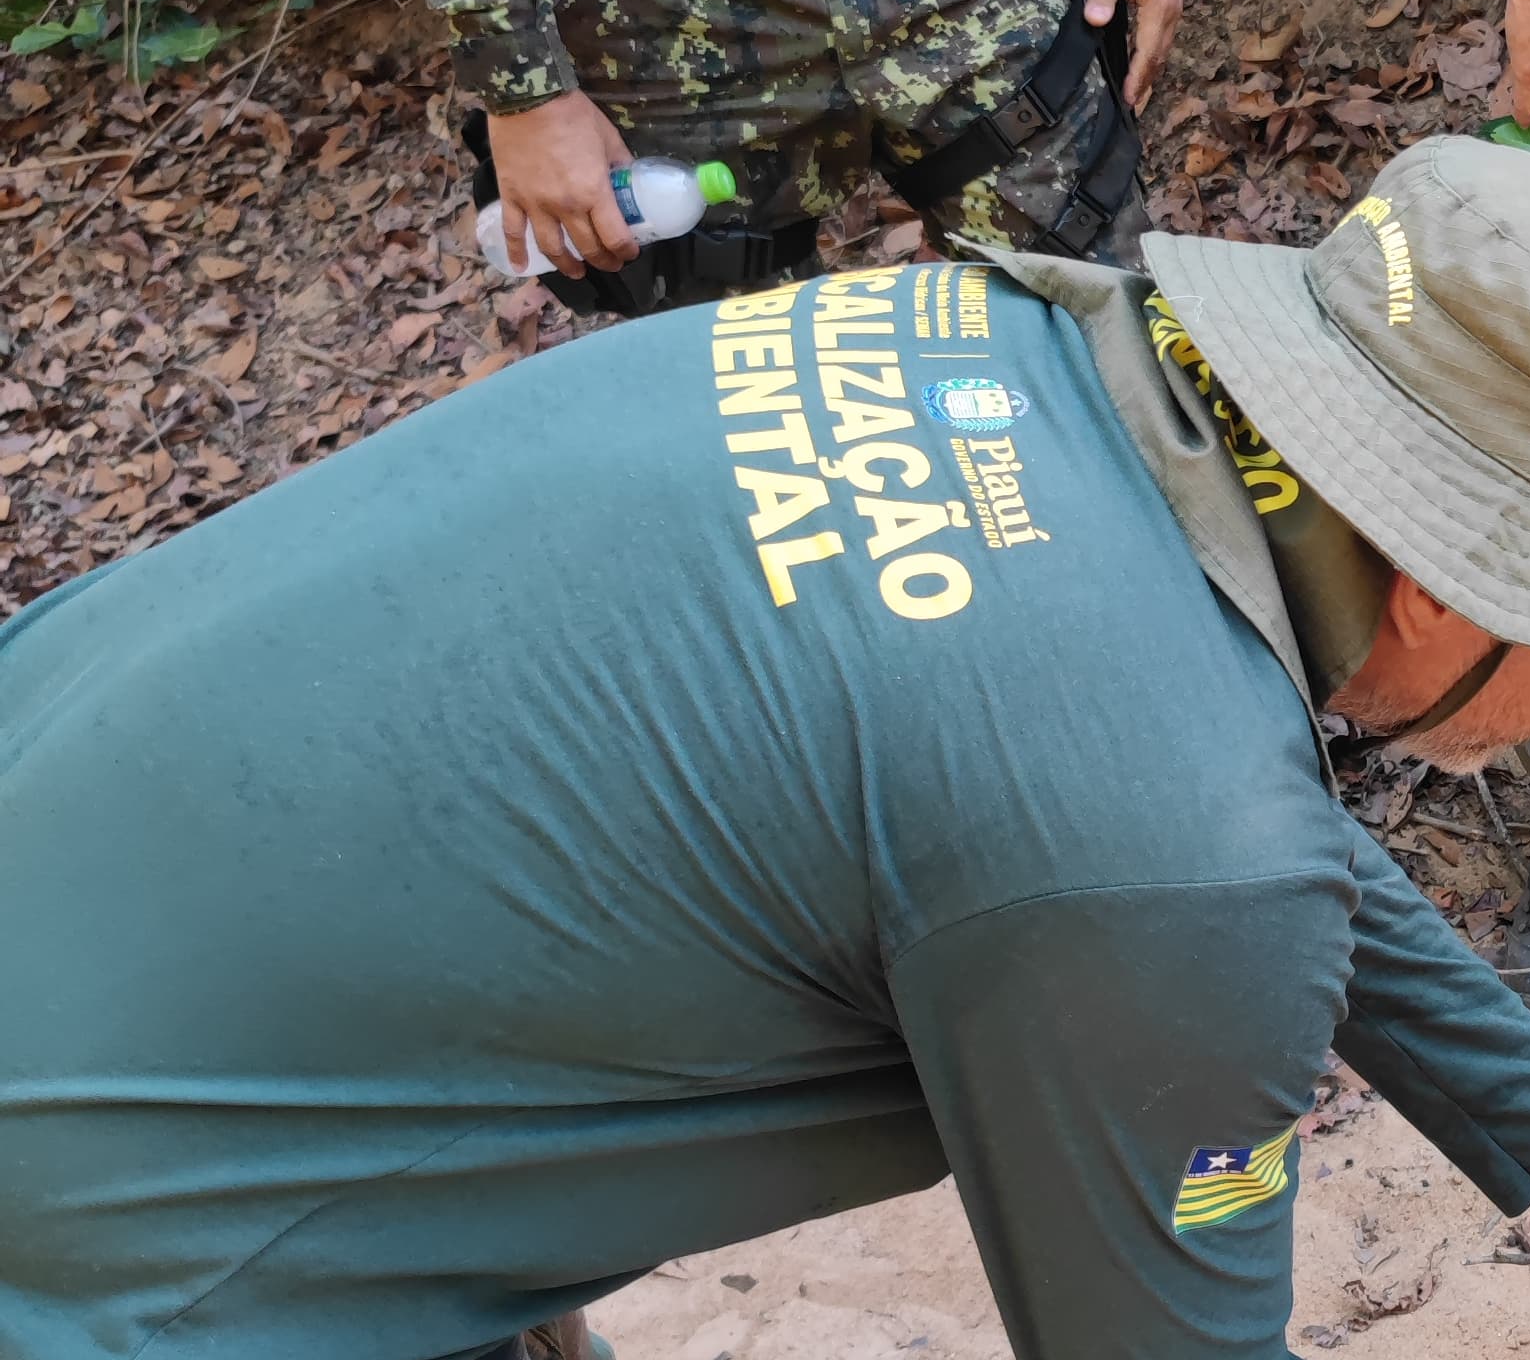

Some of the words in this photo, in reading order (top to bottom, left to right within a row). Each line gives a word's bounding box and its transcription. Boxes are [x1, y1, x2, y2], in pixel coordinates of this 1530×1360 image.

[958, 276, 990, 339] AMBIENTE
[1376, 221, 1414, 327] AMBIENTAL
[711, 281, 845, 608] BIENTAL
[813, 266, 974, 621] CALIZAÇÃO
[950, 438, 979, 483] GOVERNO
[967, 435, 1051, 548] Piauí
[968, 484, 986, 500] DO
[974, 501, 1003, 548] ESTADO
